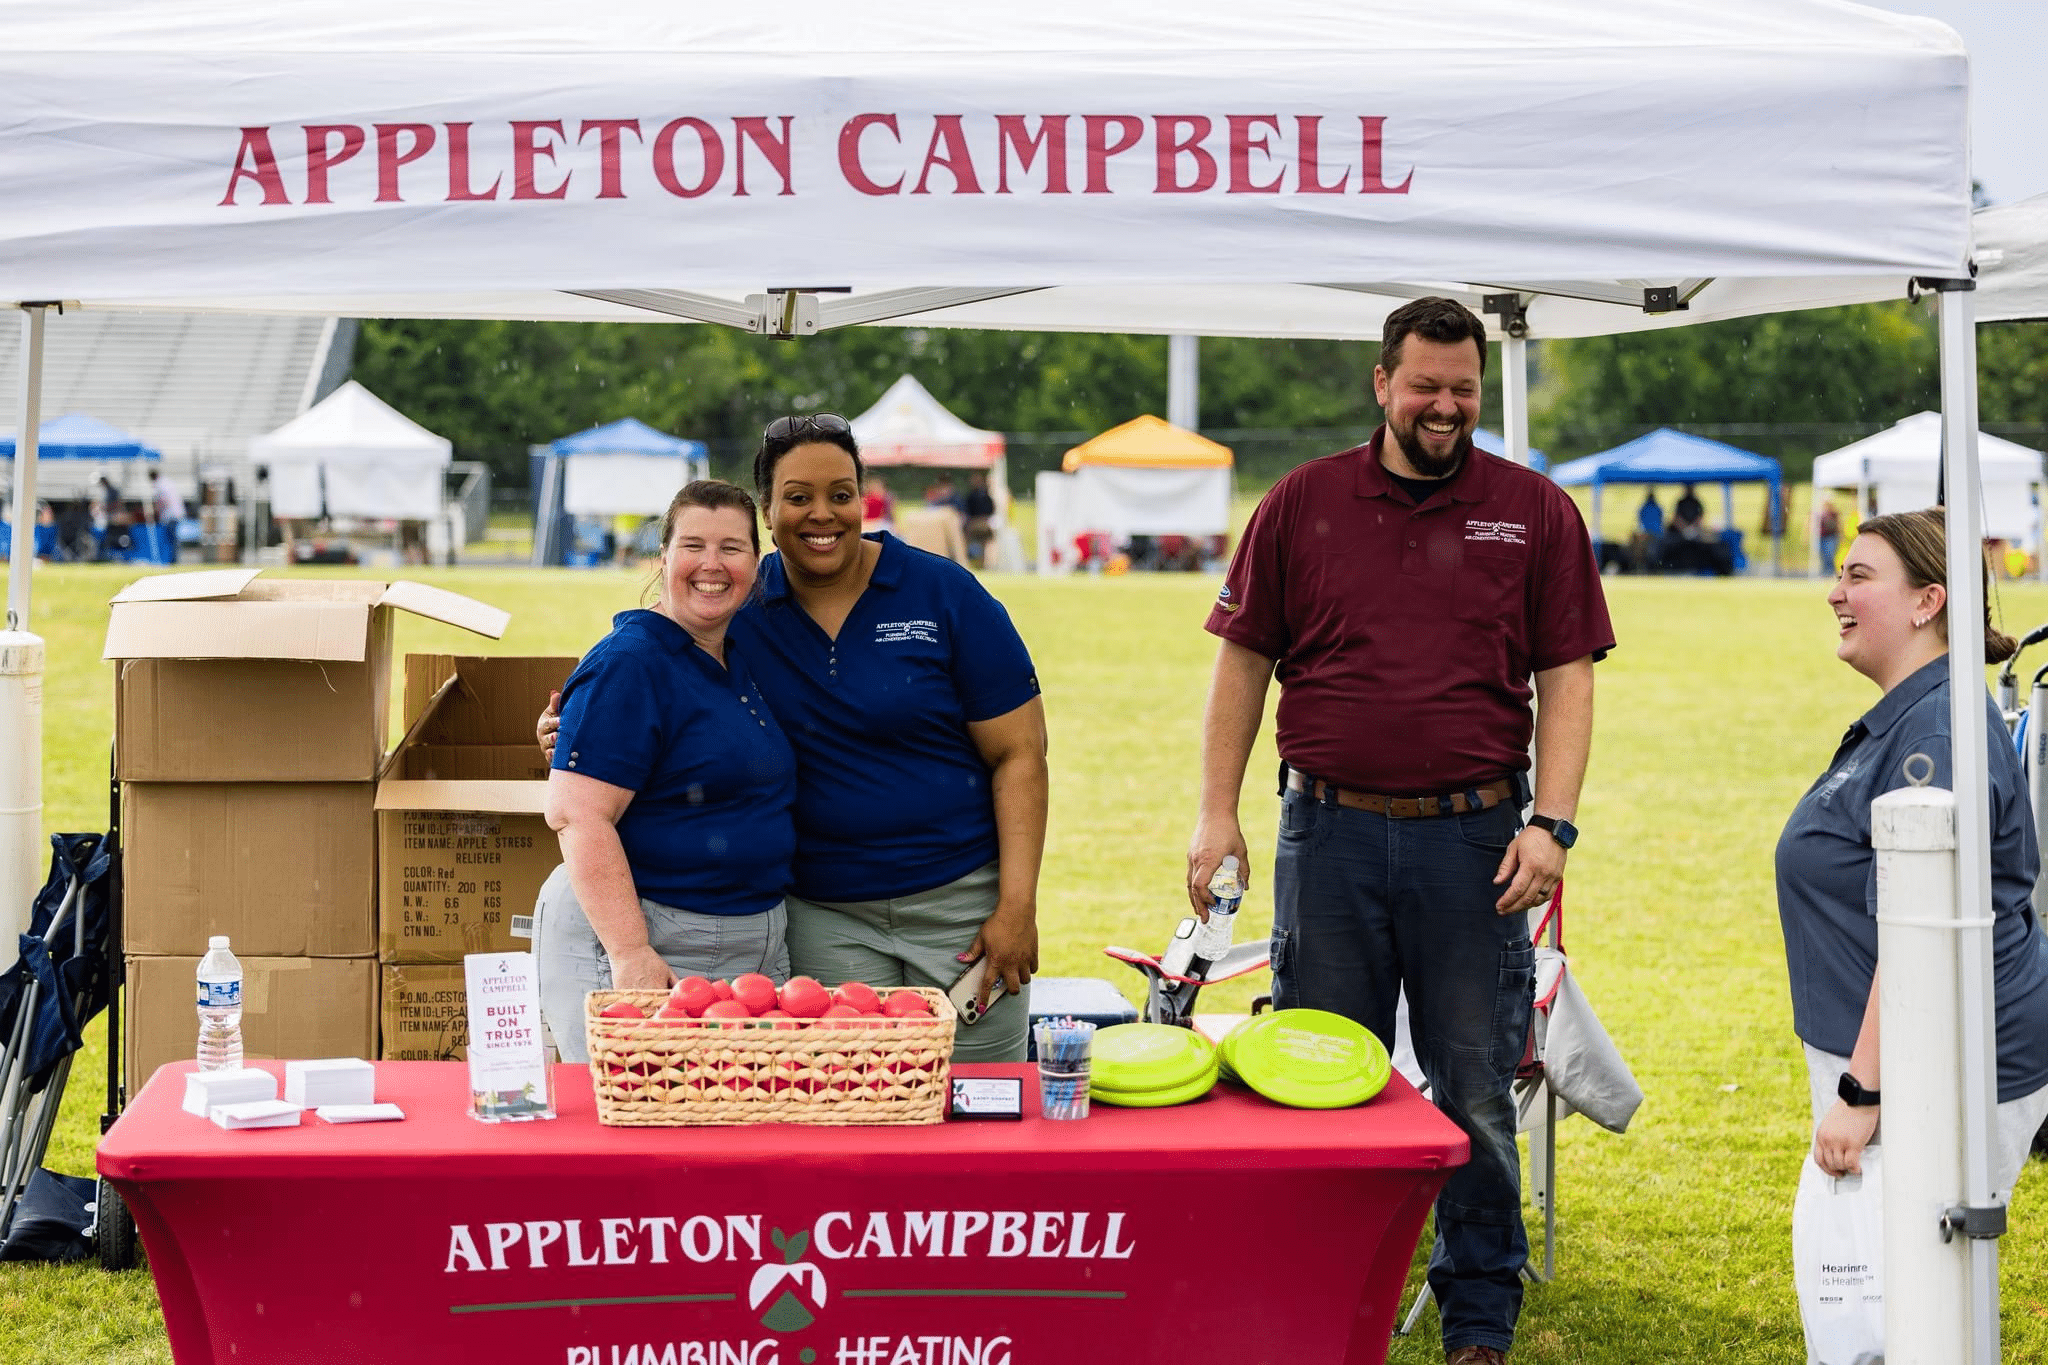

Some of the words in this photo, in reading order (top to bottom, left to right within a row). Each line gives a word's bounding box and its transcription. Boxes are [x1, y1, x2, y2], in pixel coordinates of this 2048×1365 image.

[217, 116, 797, 207] APPLETON
[838, 112, 1415, 196] CAMPBELL
[1498, 521, 1526, 530] CAMPBELL
[404, 824, 425, 835] ITEM
[404, 838, 425, 848] ITEM
[428, 838, 454, 849] NAME:
[457, 838, 487, 848] APPLE
[496, 837, 533, 848] STRESS
[456, 853, 501, 864] RELIEVER
[404, 867, 435, 878] COLOR:
[438, 868, 454, 878] Red
[404, 880, 450, 893] QUANTITY:
[457, 882, 476, 894] 200
[484, 881, 501, 892] PCS
[445, 898, 459, 908] 6.6
[484, 897, 501, 908] KGS
[444, 914, 459, 924] 7.3
[484, 912, 501, 923] KGS
[404, 926, 421, 936] CTN
[424, 926, 442, 936] NO.:
[482, 976, 527, 984] APPLETON
[482, 985, 527, 993] CAMPBELL
[400, 1007, 420, 1017] ITEM
[487, 1005, 527, 1016] BUILT
[400, 1021, 420, 1032] ITEM
[422, 1021, 449, 1032] NAME:
[498, 1018, 518, 1027] ON
[486, 1029, 531, 1040] TRUST
[401, 1050, 432, 1060] COLOR:
[444, 1214, 763, 1273] APPLETON
[814, 1211, 1136, 1260] CAMPBELL
[1822, 1277, 1830, 1286] is
[835, 1336, 1012, 1365] HEATING
